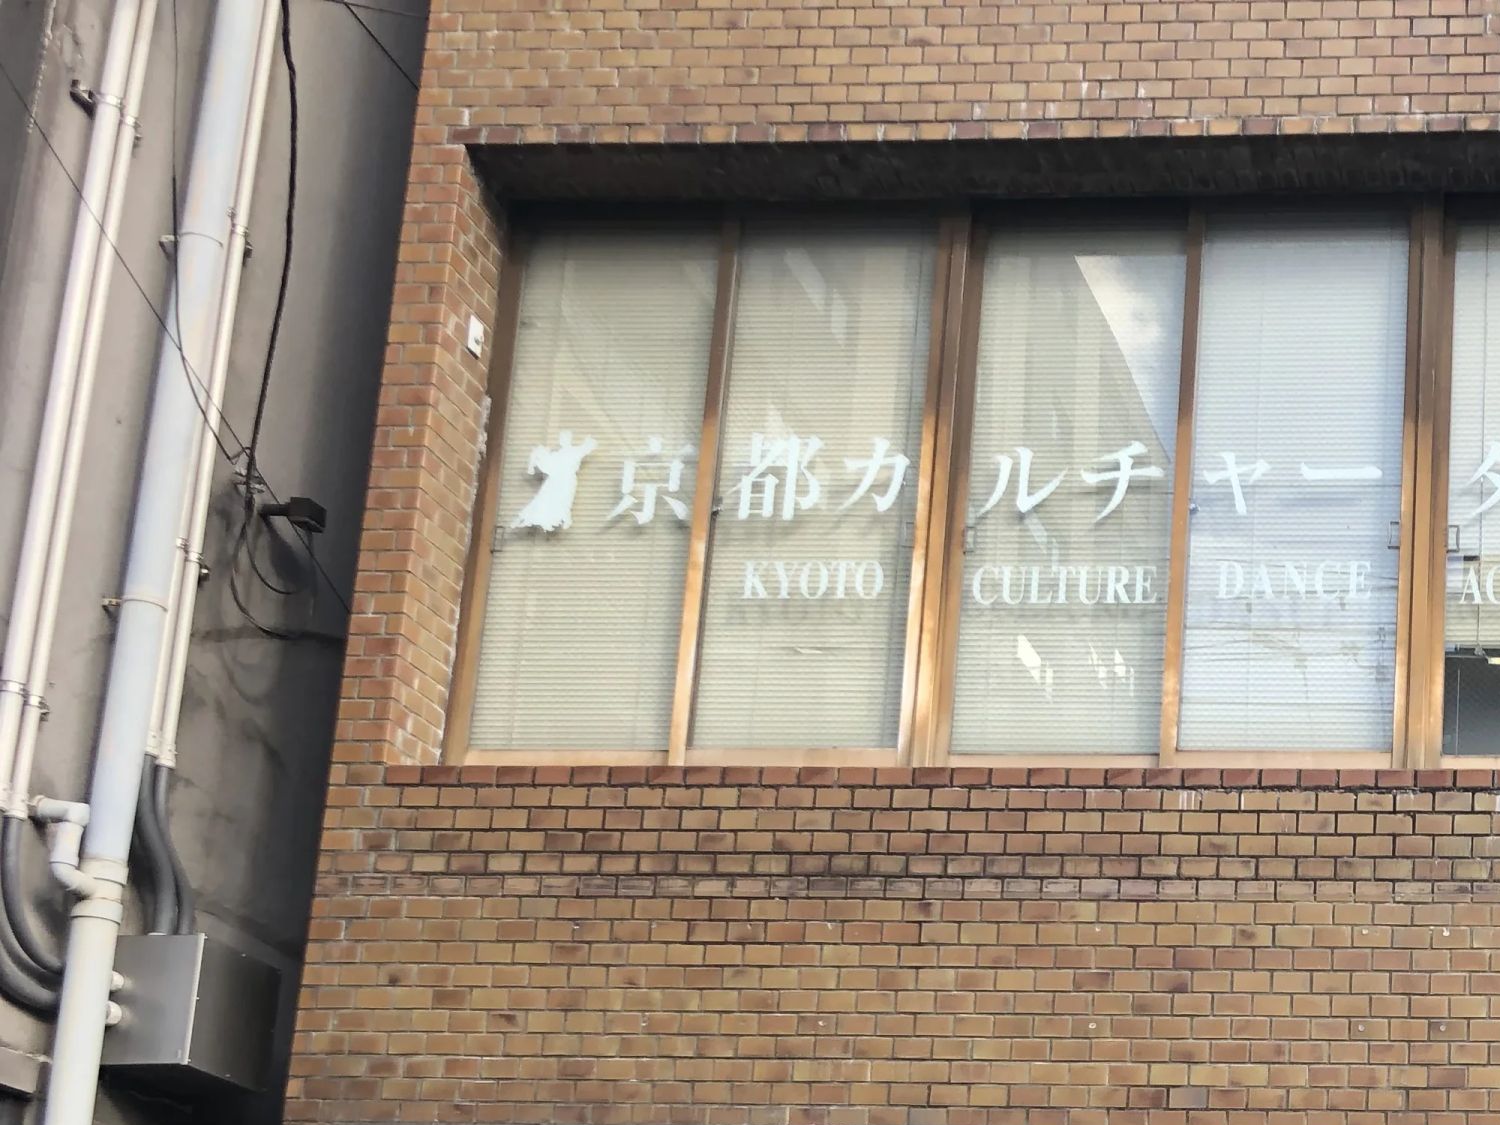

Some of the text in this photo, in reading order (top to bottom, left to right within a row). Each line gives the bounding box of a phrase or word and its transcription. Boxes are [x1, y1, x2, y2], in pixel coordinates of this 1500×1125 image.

[742, 559, 885, 601] KYOTO
[971, 563, 1158, 605] CULTURE
[1216, 559, 1373, 601] DANCE
